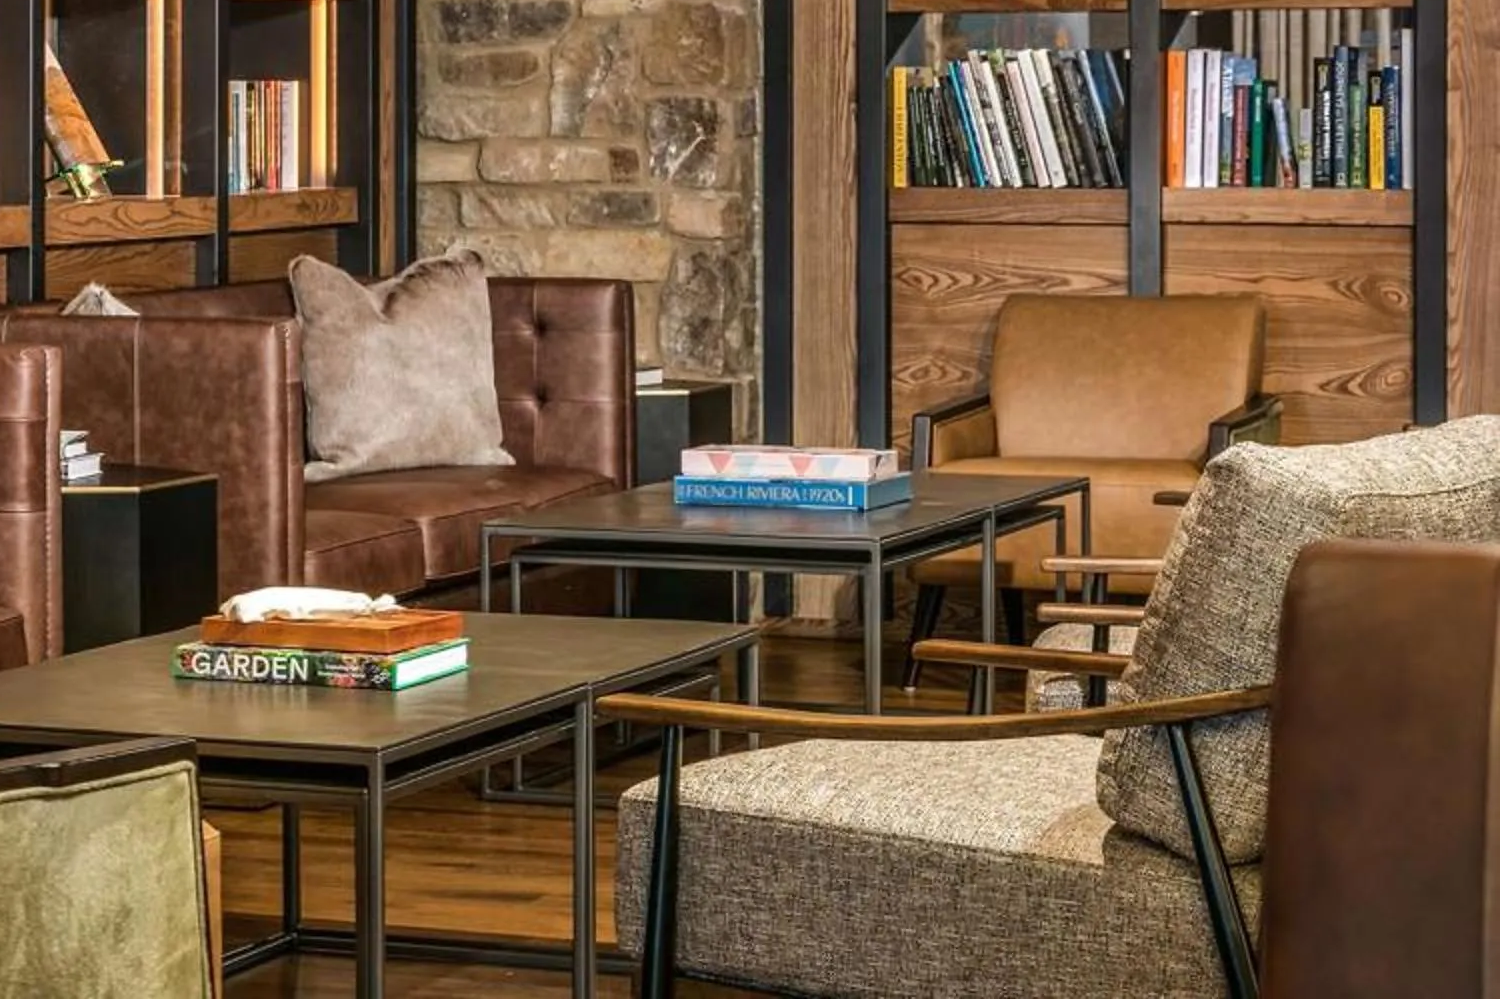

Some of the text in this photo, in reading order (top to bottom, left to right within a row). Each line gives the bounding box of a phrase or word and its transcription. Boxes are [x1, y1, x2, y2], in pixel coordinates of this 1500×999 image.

[686, 484, 743, 499] FRENCH
[747, 485, 799, 501] RIVIERA
[191, 652, 309, 682] GARDEN
